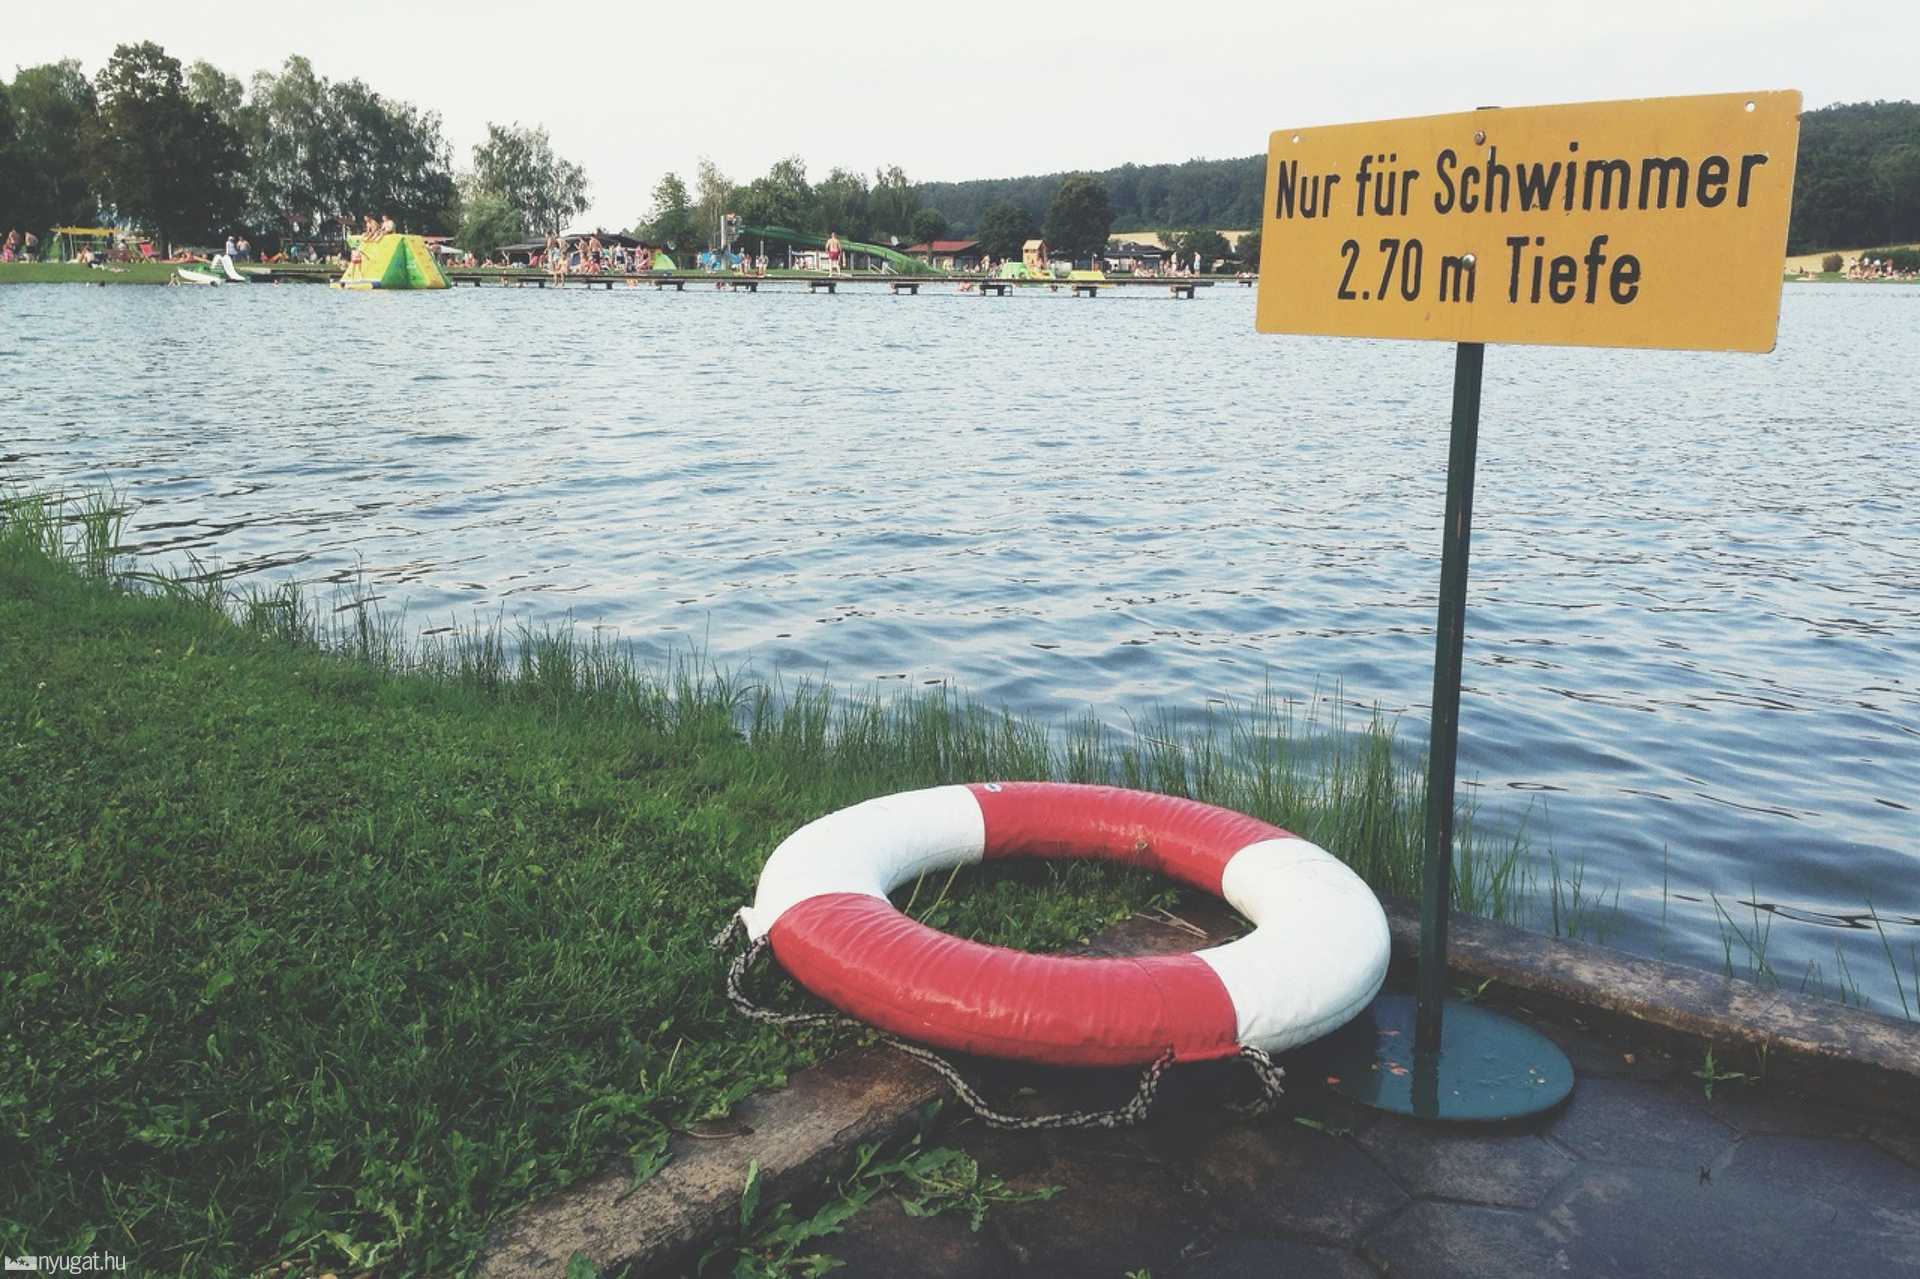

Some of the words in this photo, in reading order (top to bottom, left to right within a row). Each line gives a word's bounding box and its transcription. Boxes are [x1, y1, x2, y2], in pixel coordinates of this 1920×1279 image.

[1275, 159, 1341, 220] Nur
[1355, 153, 1420, 217] für
[1434, 141, 1769, 215] Schwimmer
[1337, 238, 1423, 302] 2.70
[1439, 255, 1477, 303] m
[1506, 234, 1642, 305] Tiefe
